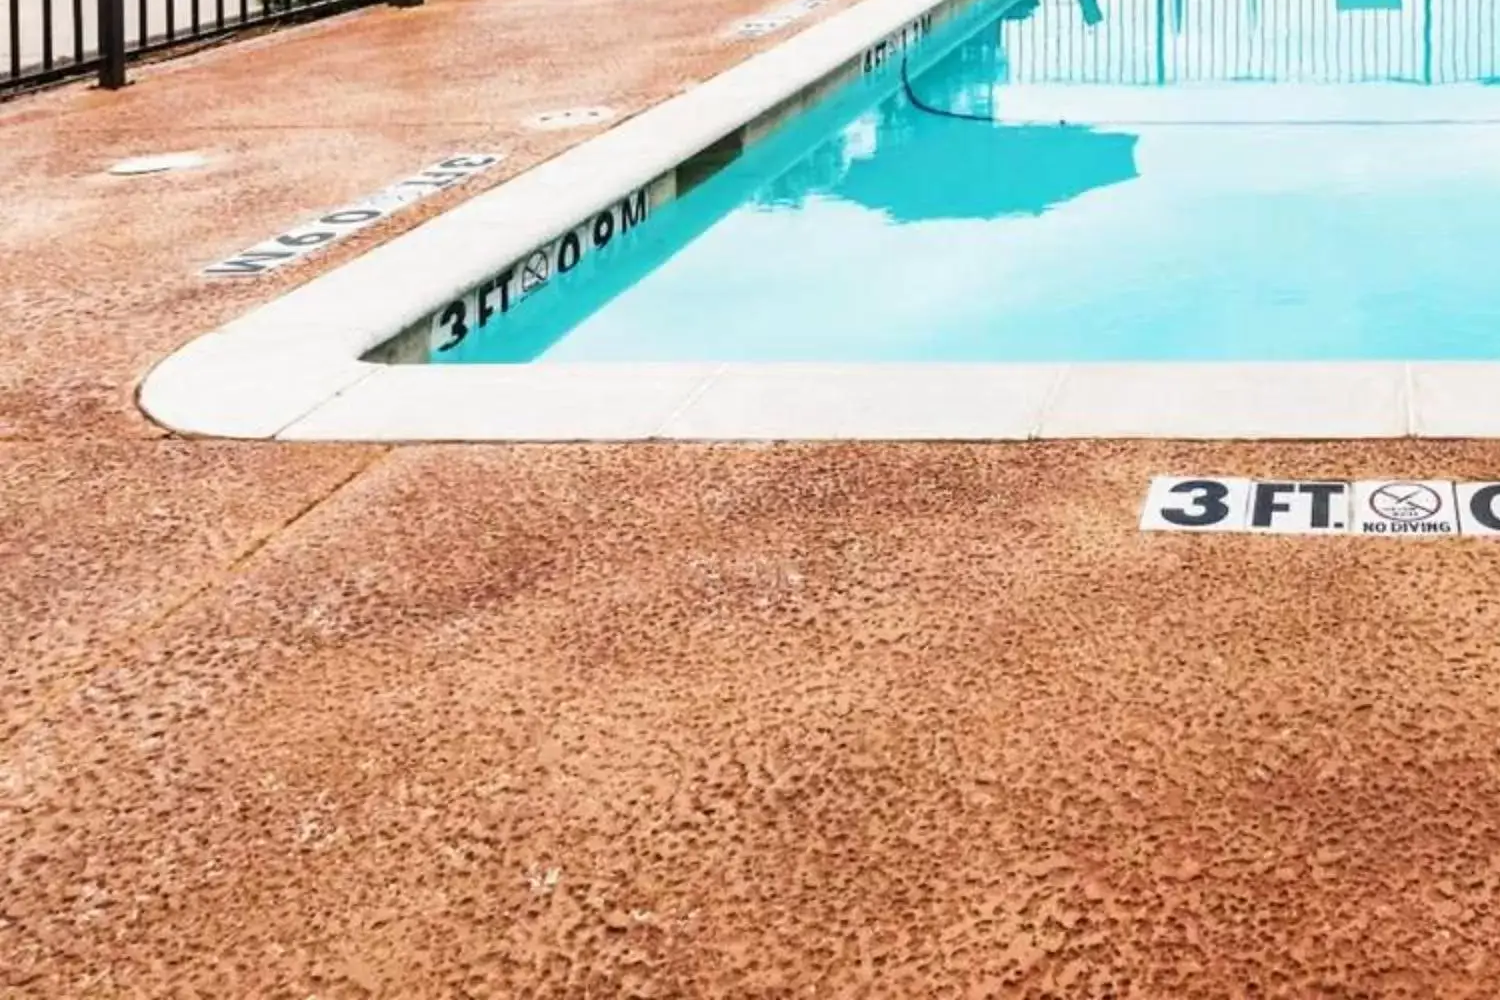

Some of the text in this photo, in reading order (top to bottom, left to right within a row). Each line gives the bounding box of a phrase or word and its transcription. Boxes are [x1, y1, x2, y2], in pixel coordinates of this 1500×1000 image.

[438, 301, 468, 352] 3
[1161, 480, 1230, 526] 3
[1252, 483, 1344, 528] FT.
[1363, 521, 1451, 533] NO DIVING
